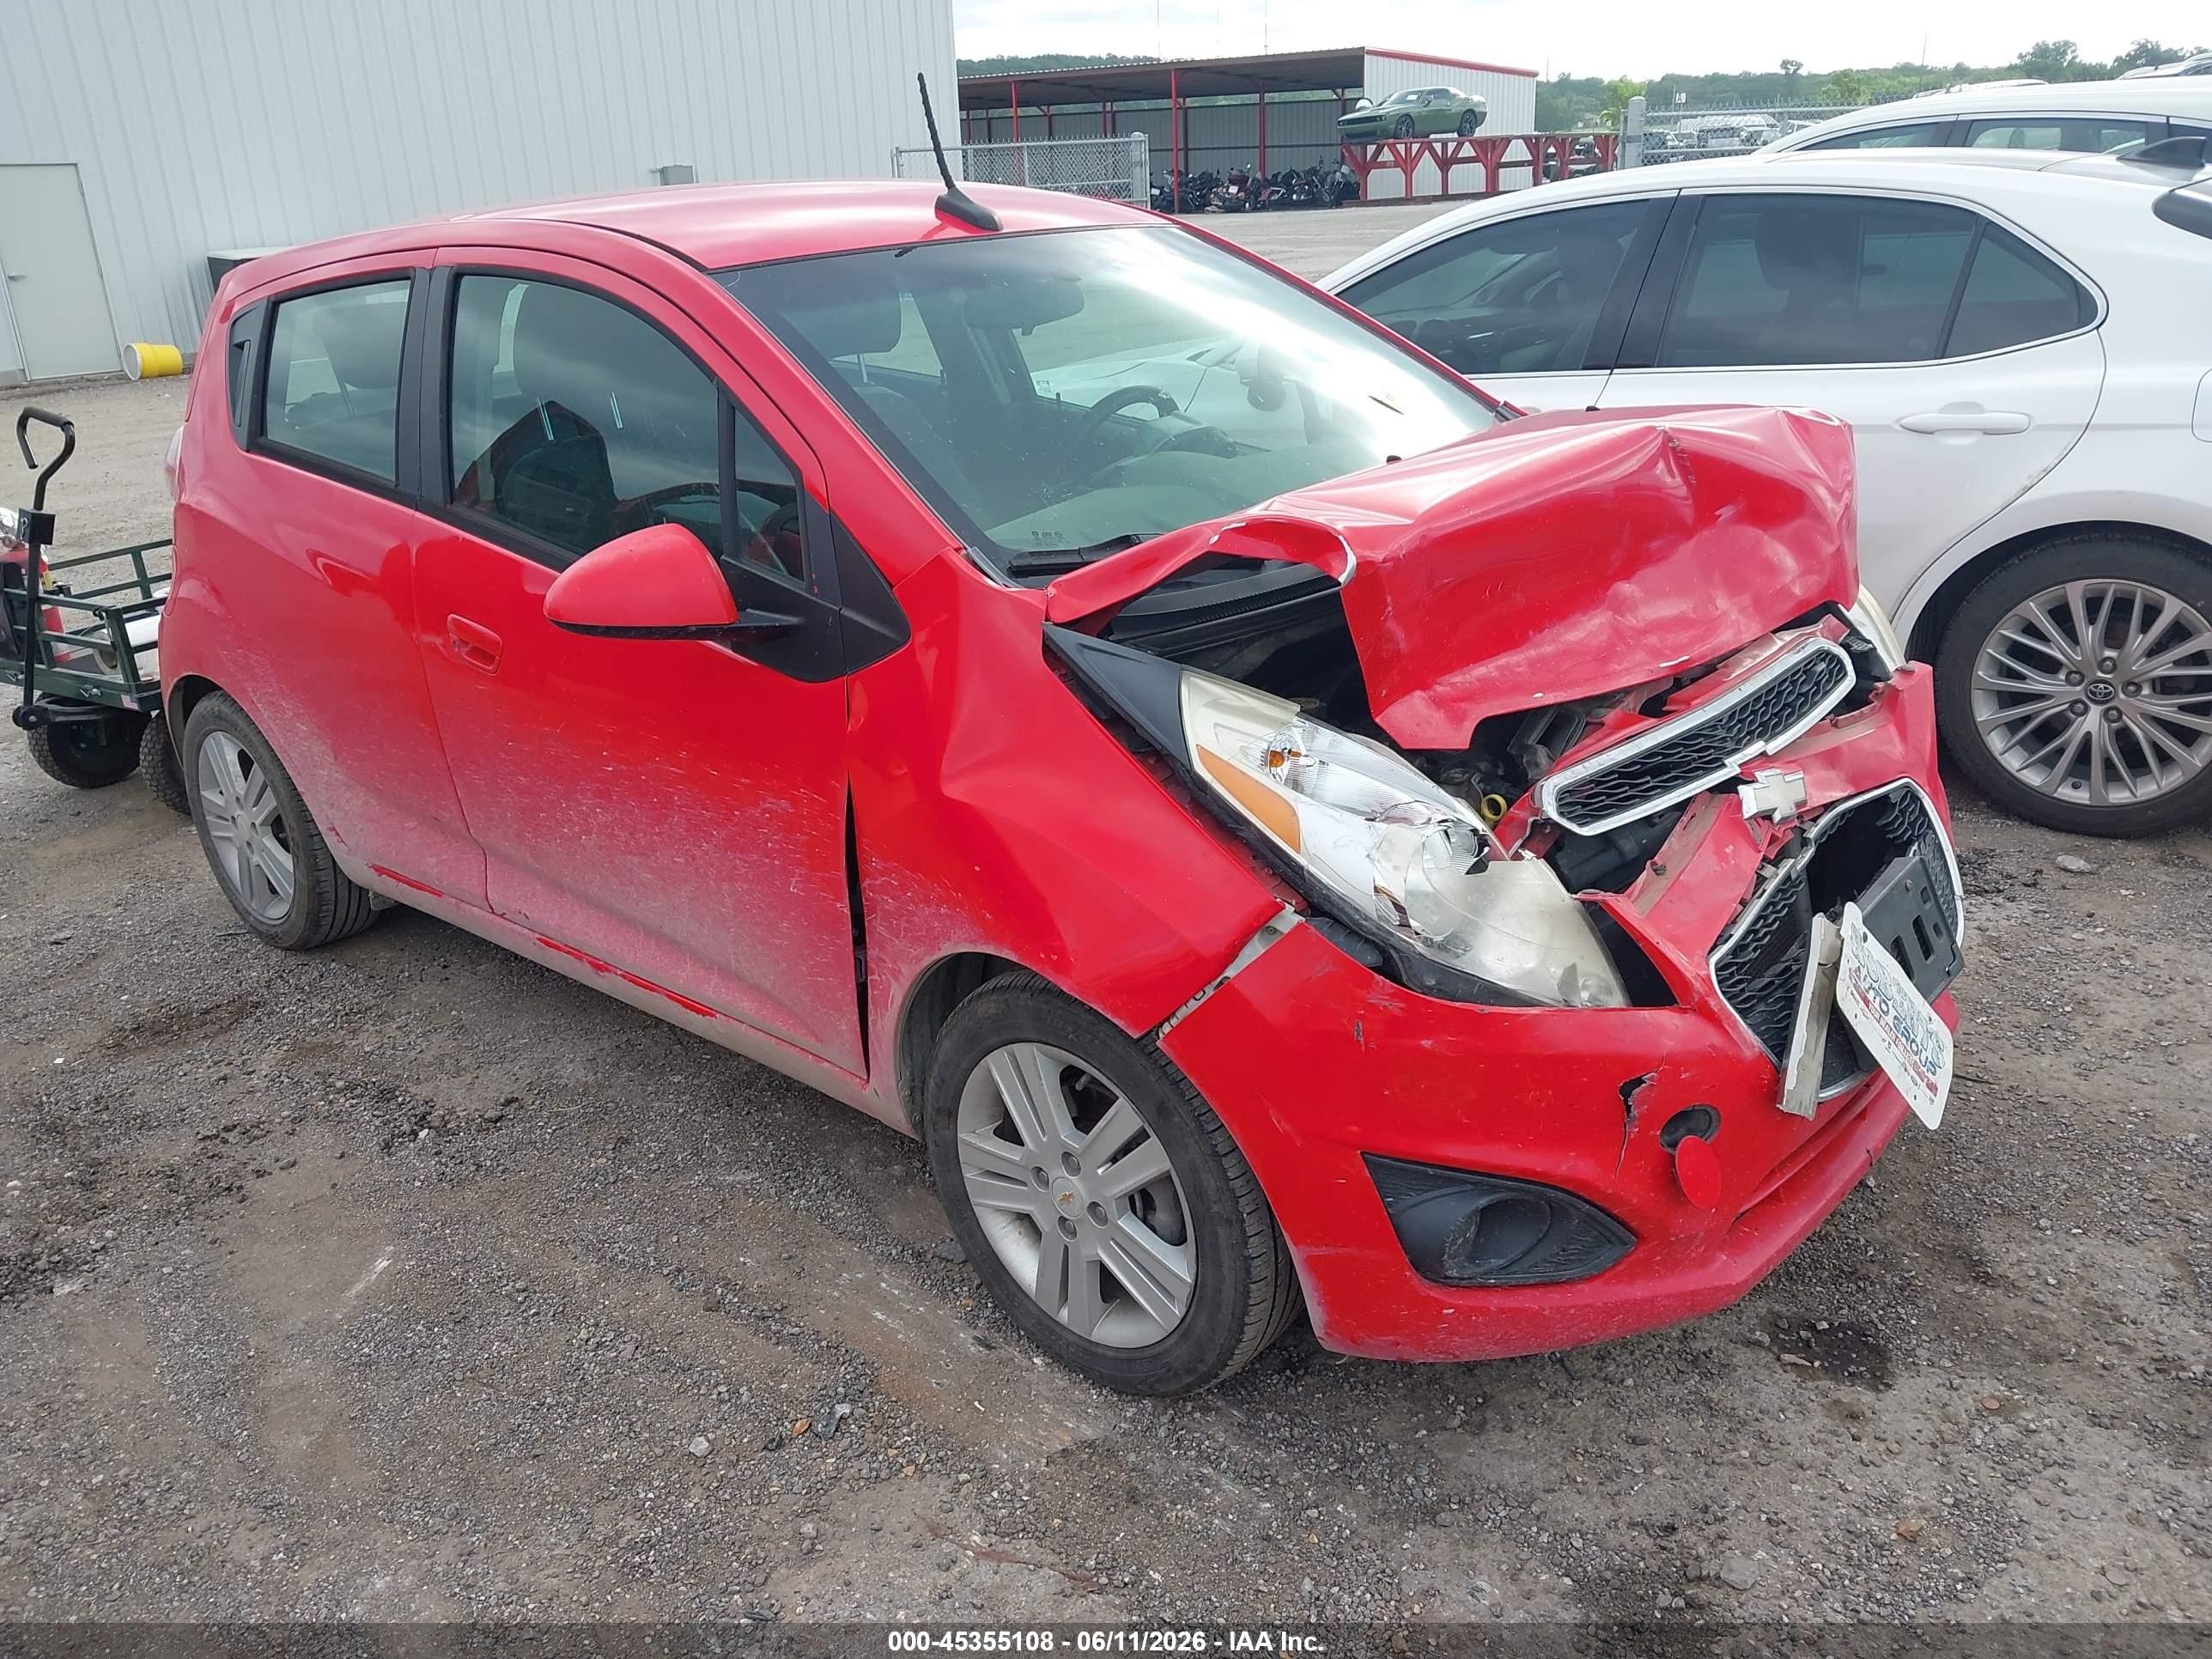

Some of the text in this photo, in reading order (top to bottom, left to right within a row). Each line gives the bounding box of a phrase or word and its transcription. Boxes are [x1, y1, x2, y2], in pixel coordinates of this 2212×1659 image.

[1853, 964, 1890, 1017] AUTO
[1893, 1014, 1937, 1077] GROUP
[1869, 1002, 1880, 1023] YOUR
